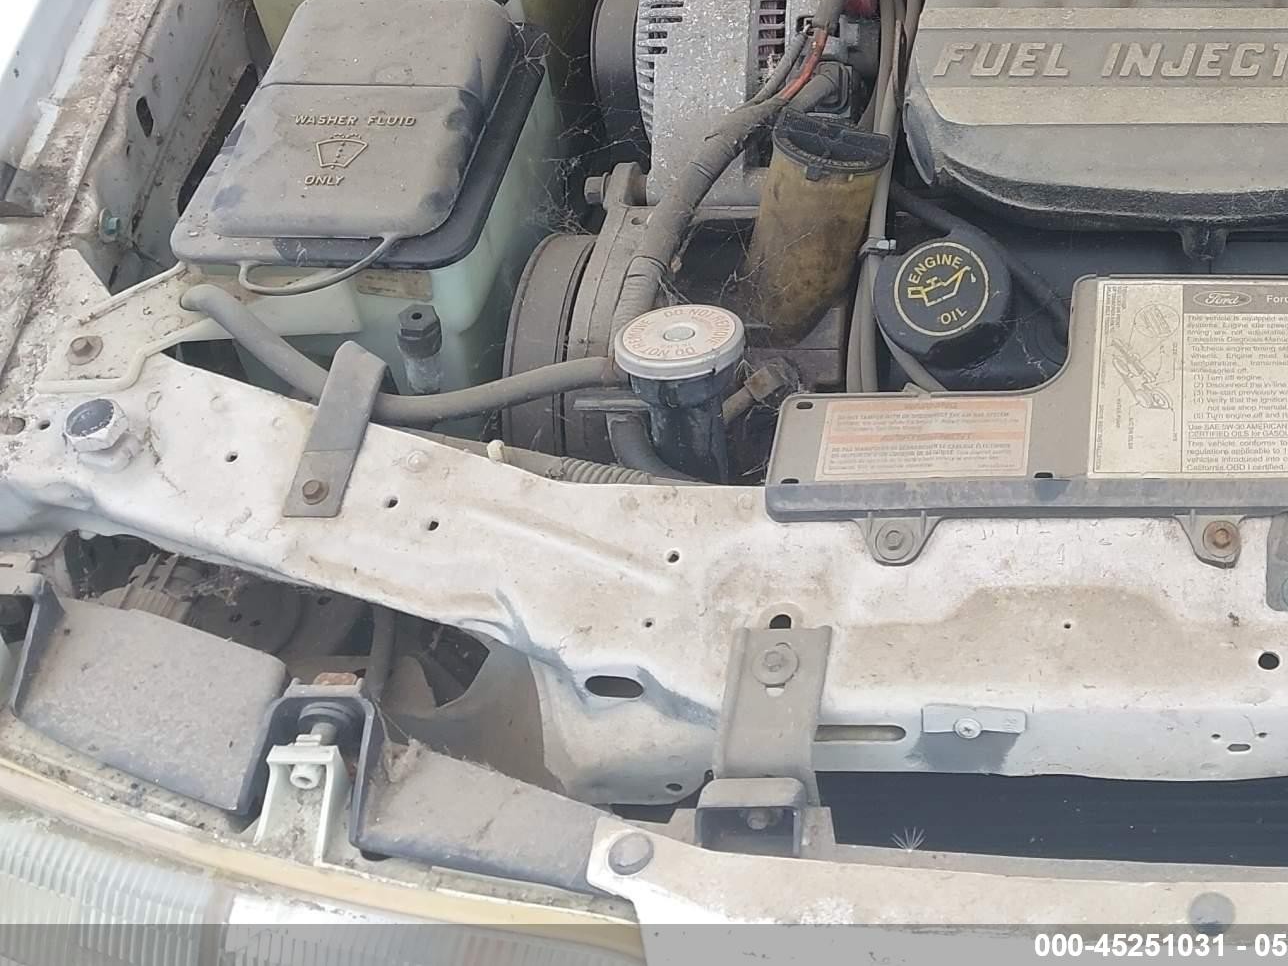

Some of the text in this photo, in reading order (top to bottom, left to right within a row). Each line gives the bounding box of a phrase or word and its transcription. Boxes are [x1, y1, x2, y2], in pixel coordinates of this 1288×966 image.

[933, 42, 1070, 78] FUEL
[294, 114, 416, 126] WASHER FLUID
[304, 174, 345, 186] ONLY
[908, 254, 963, 284] ENGINE
[1204, 292, 1240, 305] Ford
[664, 308, 731, 345] DO NOT REMOVE
[940, 306, 968, 324] OIL
[628, 319, 696, 357] DO NOT REMOVE
